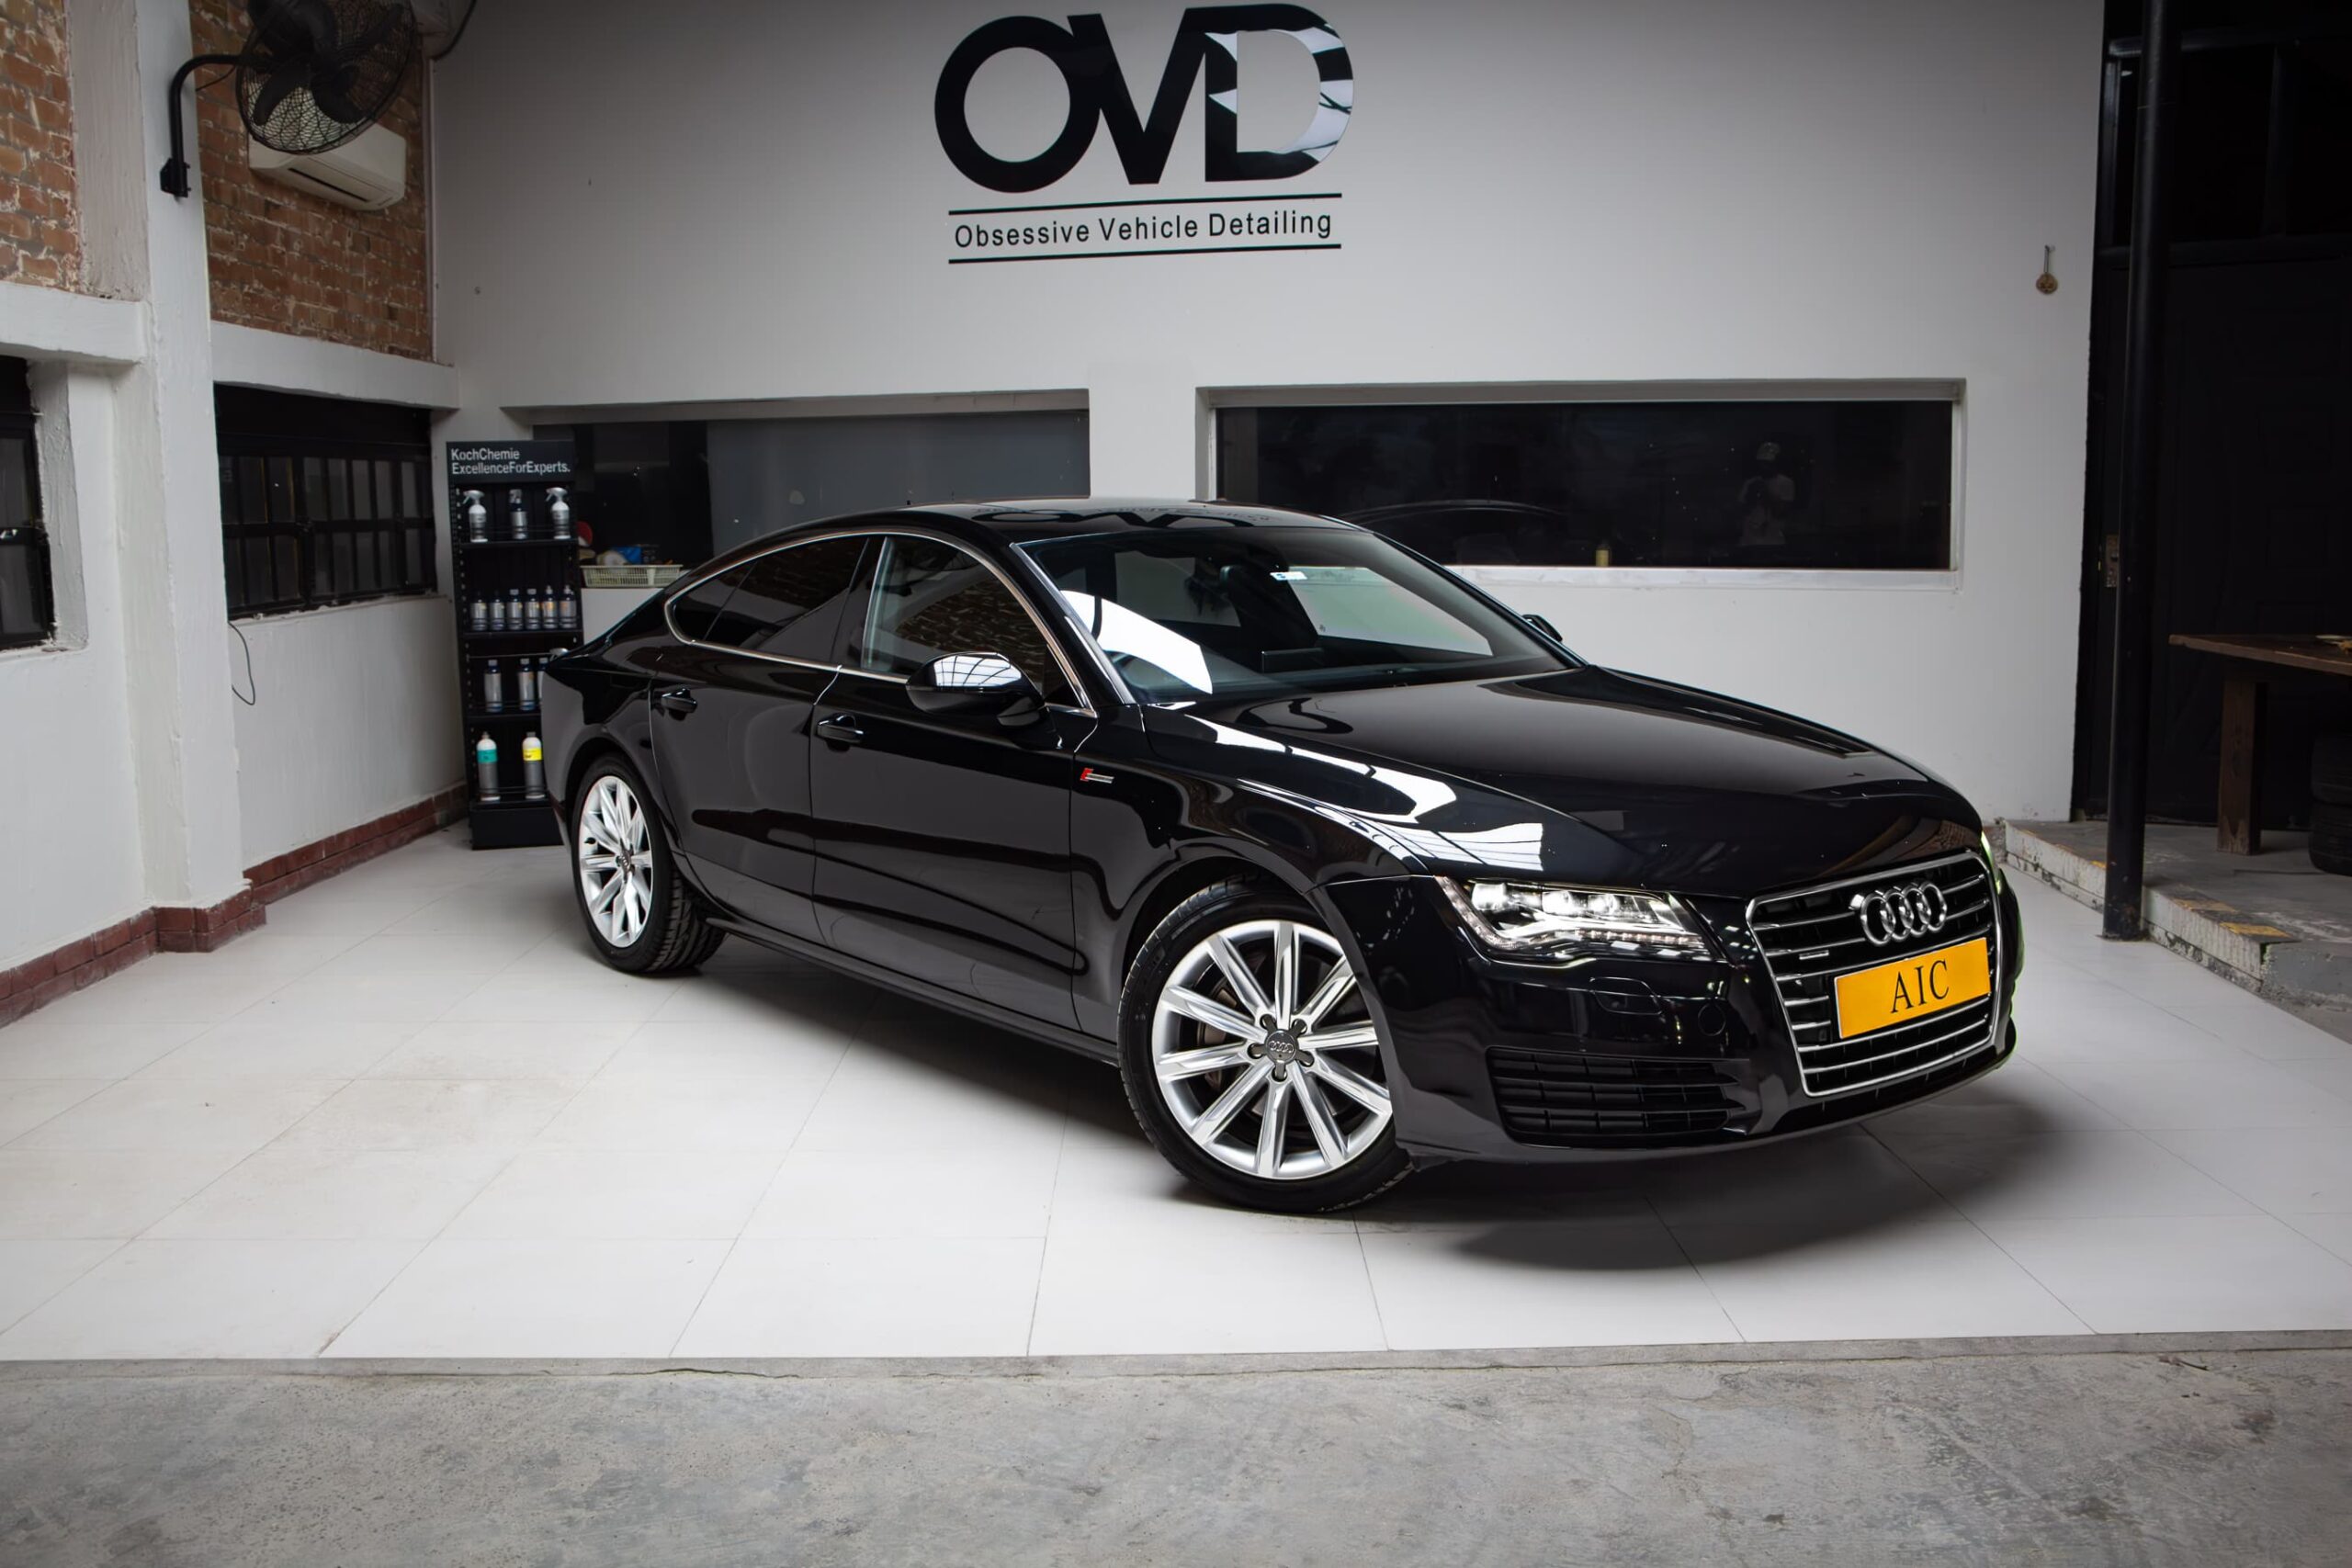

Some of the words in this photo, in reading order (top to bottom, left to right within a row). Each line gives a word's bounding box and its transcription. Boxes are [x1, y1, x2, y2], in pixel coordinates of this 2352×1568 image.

[934, 3, 1353, 193] OVD
[955, 220, 1090, 248] Obsessive
[1098, 215, 1198, 241] Vehicle
[1209, 210, 1331, 239] Detailing
[450, 447, 520, 461] KochChemie
[452, 461, 571, 476] ExcellenceForExperts.
[1890, 959, 1950, 1014] AIC
